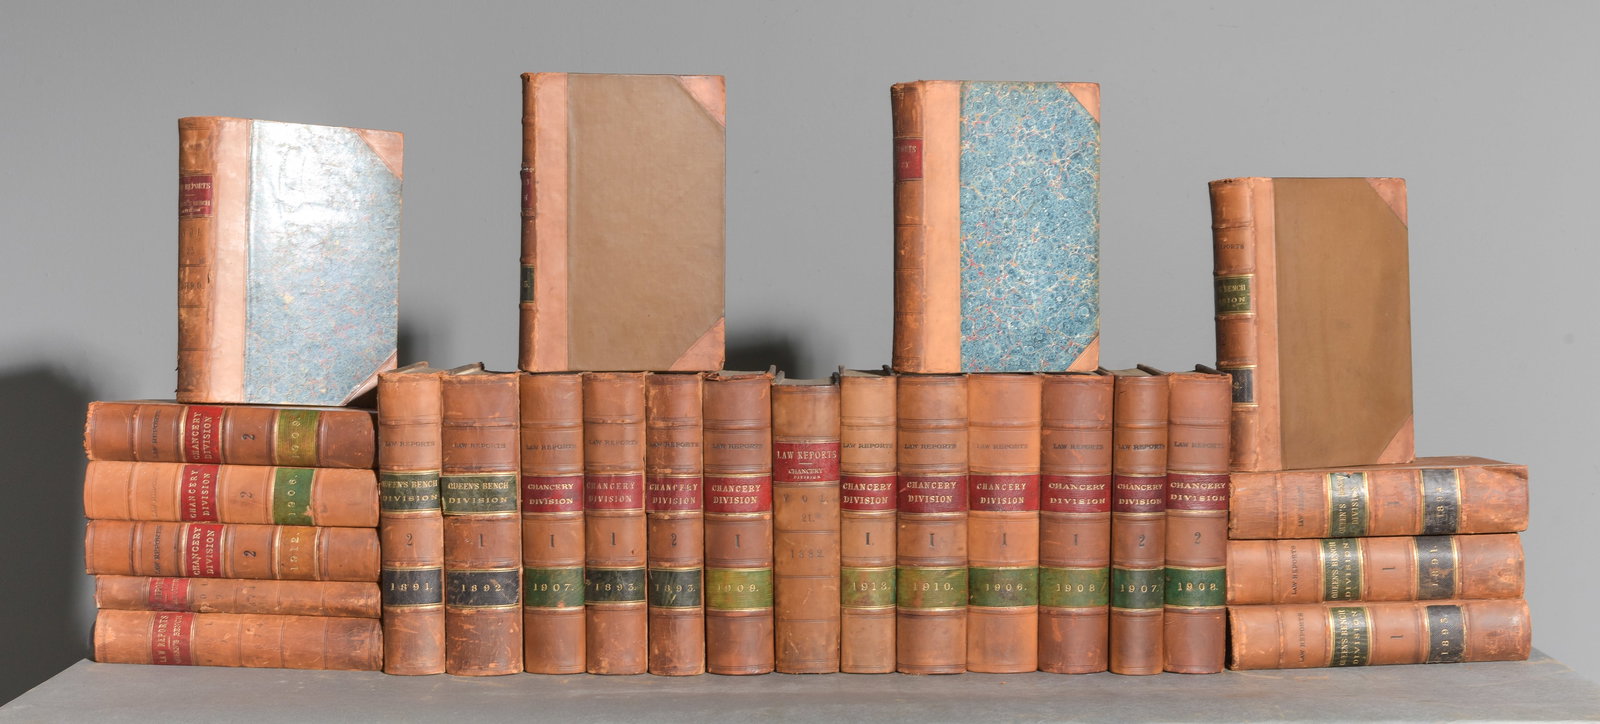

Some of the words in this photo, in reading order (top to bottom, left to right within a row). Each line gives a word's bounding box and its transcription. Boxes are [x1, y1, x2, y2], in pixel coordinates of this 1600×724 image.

[192, 412, 202, 460] CHANCERY
[203, 416, 212, 459] DIVISION
[777, 451, 794, 459] LAW
[797, 450, 837, 460] REPORTS
[411, 480, 438, 488] BENCH
[712, 484, 761, 493] CHANCERY
[843, 483, 892, 491] CHANCERY
[189, 470, 199, 518] CHANCERY
[202, 473, 211, 516] DIVISION
[844, 496, 888, 504] DIVISION
[406, 533, 413, 546] 2
[671, 533, 677, 546] 2
[1139, 534, 1145, 547] 2
[1194, 532, 1201, 544] 2
[192, 527, 201, 576] CHANCERY
[206, 530, 215, 574] DIVISION
[290, 532, 300, 571] 1912.
[1329, 541, 1339, 567] BENCH
[1343, 542, 1352, 598] DIVISION
[1430, 545, 1439, 587] 1891.
[390, 582, 433, 592] 1891.
[461, 584, 504, 592] 1892.
[534, 583, 574, 592] 1907.
[655, 584, 696, 592] 1893.
[853, 582, 890, 591] 1913.
[913, 583, 954, 591] 1910.
[1120, 584, 1160, 593] 1907.
[1178, 582, 1218, 591] 1908.
[1339, 610, 1348, 635] BENCH
[157, 615, 169, 647] REPORTS
[1352, 610, 1361, 664] DIVISION
